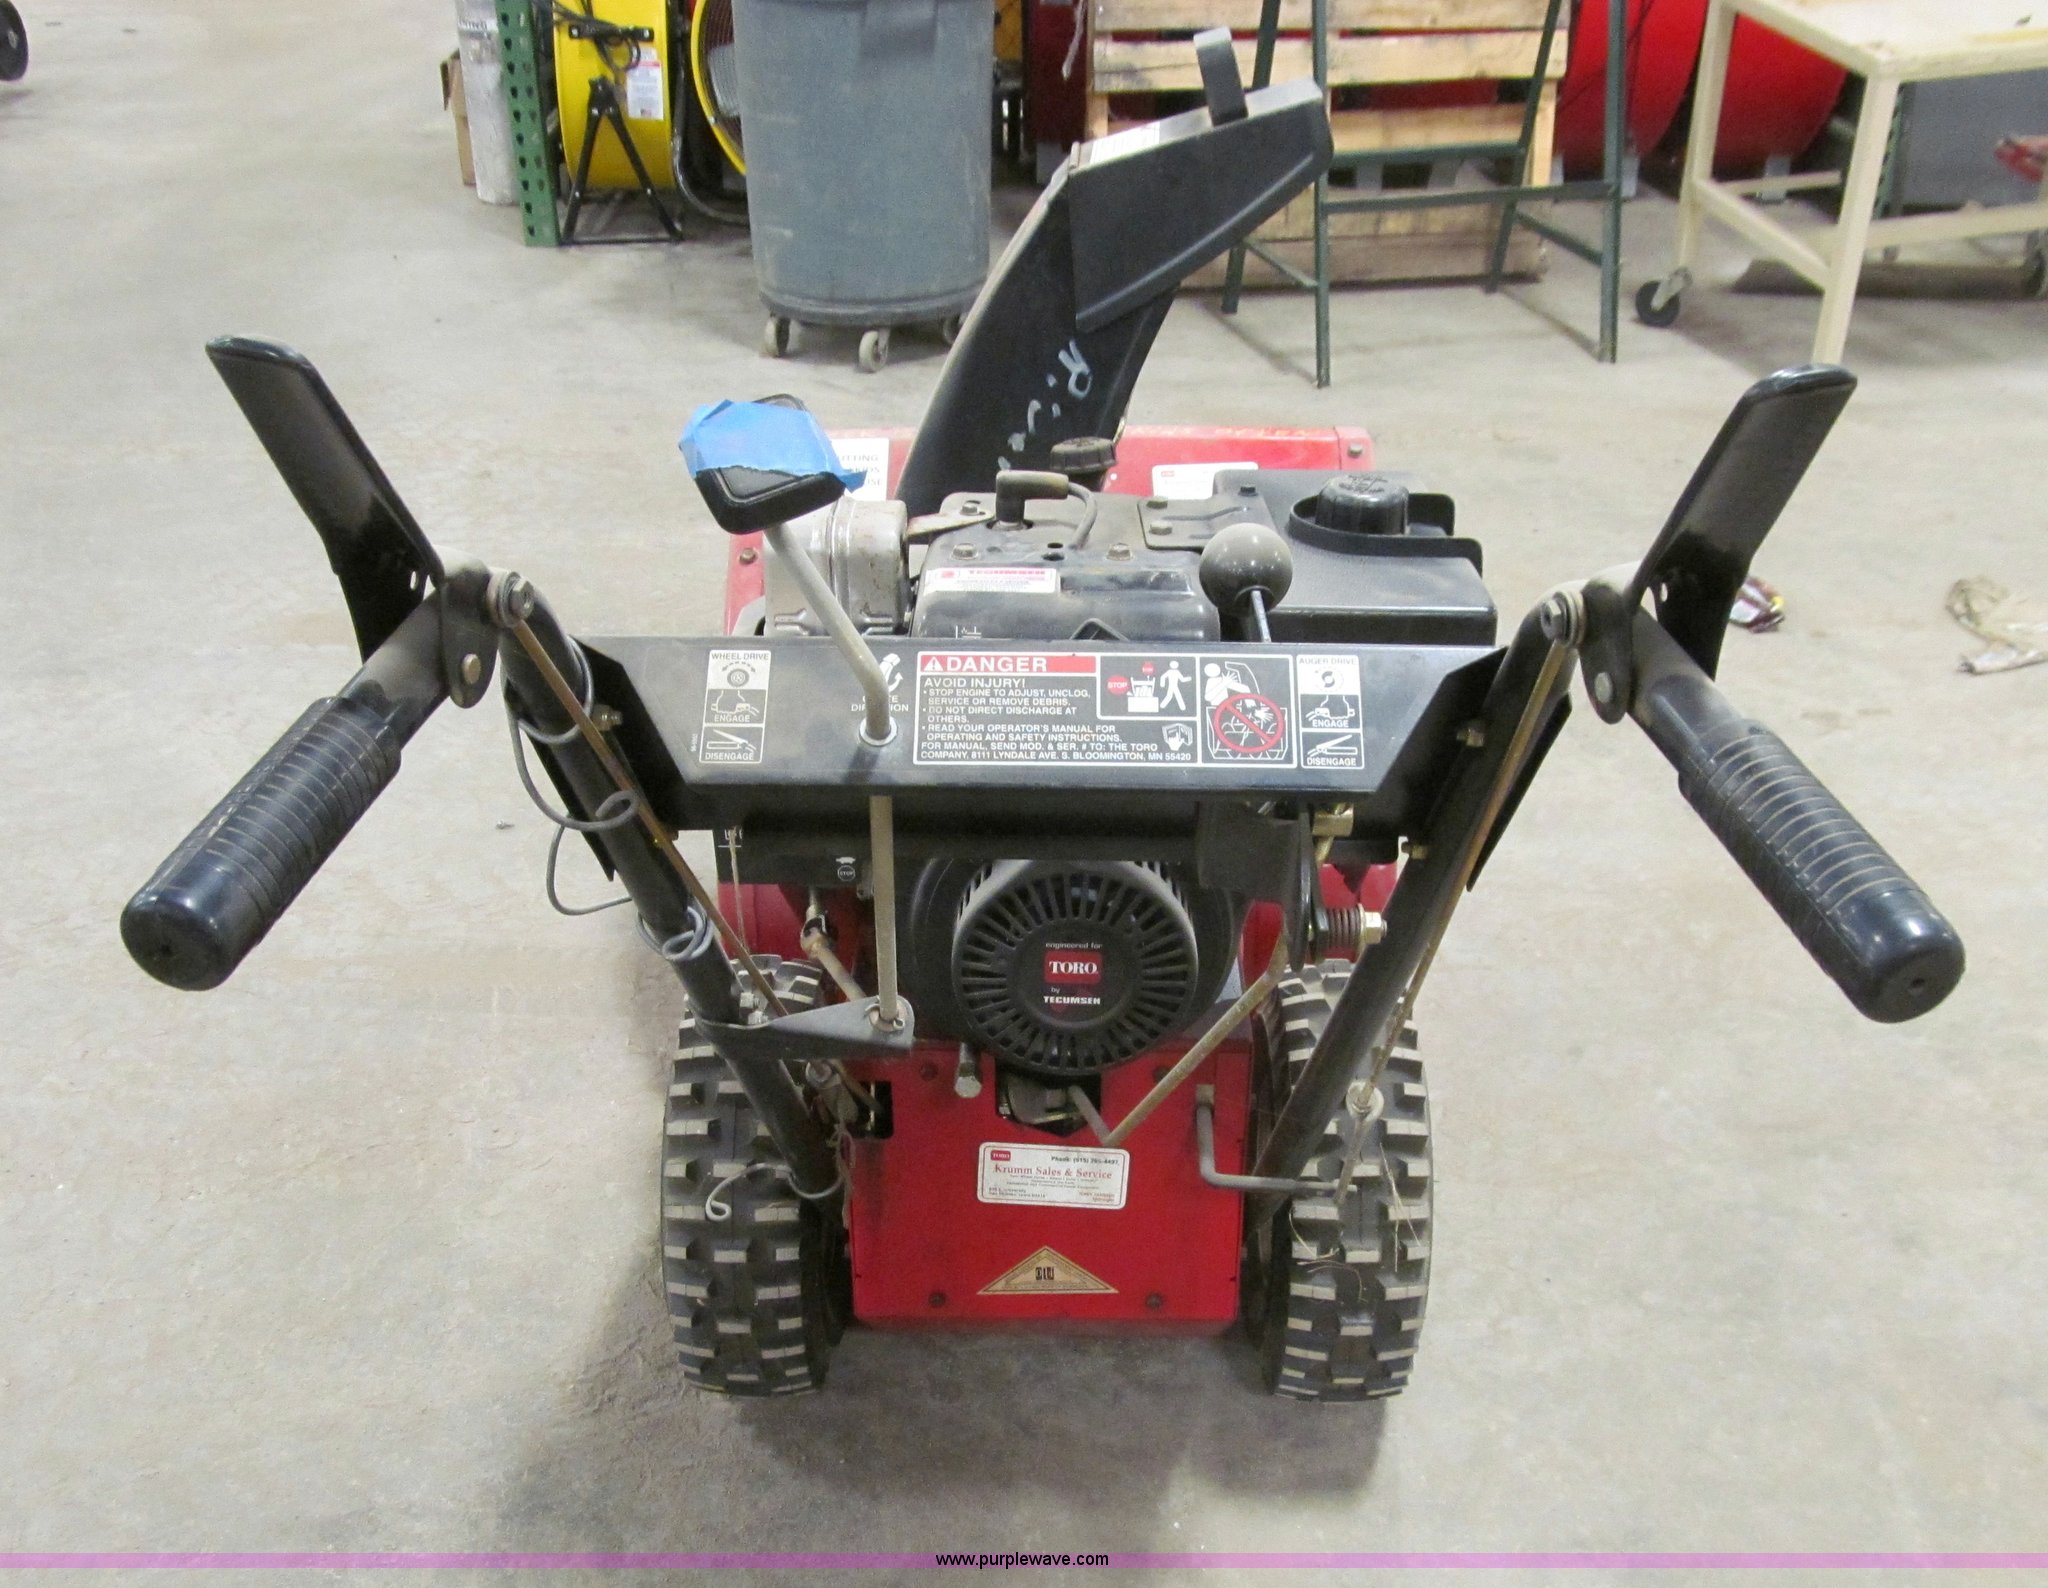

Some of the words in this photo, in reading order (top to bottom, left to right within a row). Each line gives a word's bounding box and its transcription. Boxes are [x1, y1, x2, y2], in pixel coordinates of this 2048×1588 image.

[946, 657, 1048, 672] DANGER
[1300, 657, 1329, 665] AUGER
[924, 678, 967, 688] AVOID
[970, 678, 1026, 689] INJURY!
[1107, 681, 1128, 689] STOP
[928, 689, 954, 697] STOP
[956, 689, 991, 697] ENGINE
[993, 689, 1006, 697] TO
[1008, 689, 1046, 698] ADJUST,
[1048, 690, 1091, 699] UNCLOG,
[928, 698, 970, 706] SERVICE
[972, 698, 987, 706] OR
[989, 698, 1030, 706] REMOVE
[1032, 698, 1071, 706] DEBRIS.
[851, 703, 909, 712] DIRION
[1005, 707, 1062, 715] DISCHARGE
[1064, 707, 1077, 715] AT
[714, 715, 750, 723] ENGAGE
[927, 715, 970, 723] OTHERS.
[928, 724, 955, 732] READ
[957, 724, 985, 732] YOUR
[987, 724, 1049, 733] OPERATOR'S
[1051, 725, 1093, 733] MANUAL
[1095, 725, 1116, 733] FOR
[1312, 720, 1349, 728] ENGAGE
[926, 733, 983, 741] OPERATING
[985, 733, 1006, 741] AND
[1008, 733, 1046, 741] SAFETY
[1048, 734, 1123, 743] INSTRUCTIONS.
[921, 742, 942, 750] FOR
[944, 742, 988, 751] MANUAL,
[990, 742, 1018, 750] SEND
[1019, 742, 1045, 751] MOD.
[1047, 743, 1054, 751] &
[1057, 743, 1079, 751] SER.
[1091, 743, 1106, 751] TO:
[1108, 743, 1128, 751] THE
[1130, 743, 1158, 751] TORO
[705, 752, 754, 761] DISENGAGE
[920, 751, 969, 761] COMPANY,
[971, 751, 991, 760] 8111
[993, 751, 1036, 760] LYNDALE
[1038, 752, 1060, 760] AVE.
[1061, 752, 1071, 760] S.
[1073, 752, 1146, 761] BLOOMINGTON,
[1148, 752, 1163, 760] MN
[1165, 753, 1191, 761] 55420
[1306, 757, 1357, 766] DISENGAGE
[1048, 961, 1098, 975] TORO
[1051, 986, 1060, 994] by
[993, 1164, 1033, 1175] Krumm
[1035, 1166, 1062, 1176] Sales
[1064, 1168, 1073, 1176] &
[1075, 1169, 1113, 1180] Service
